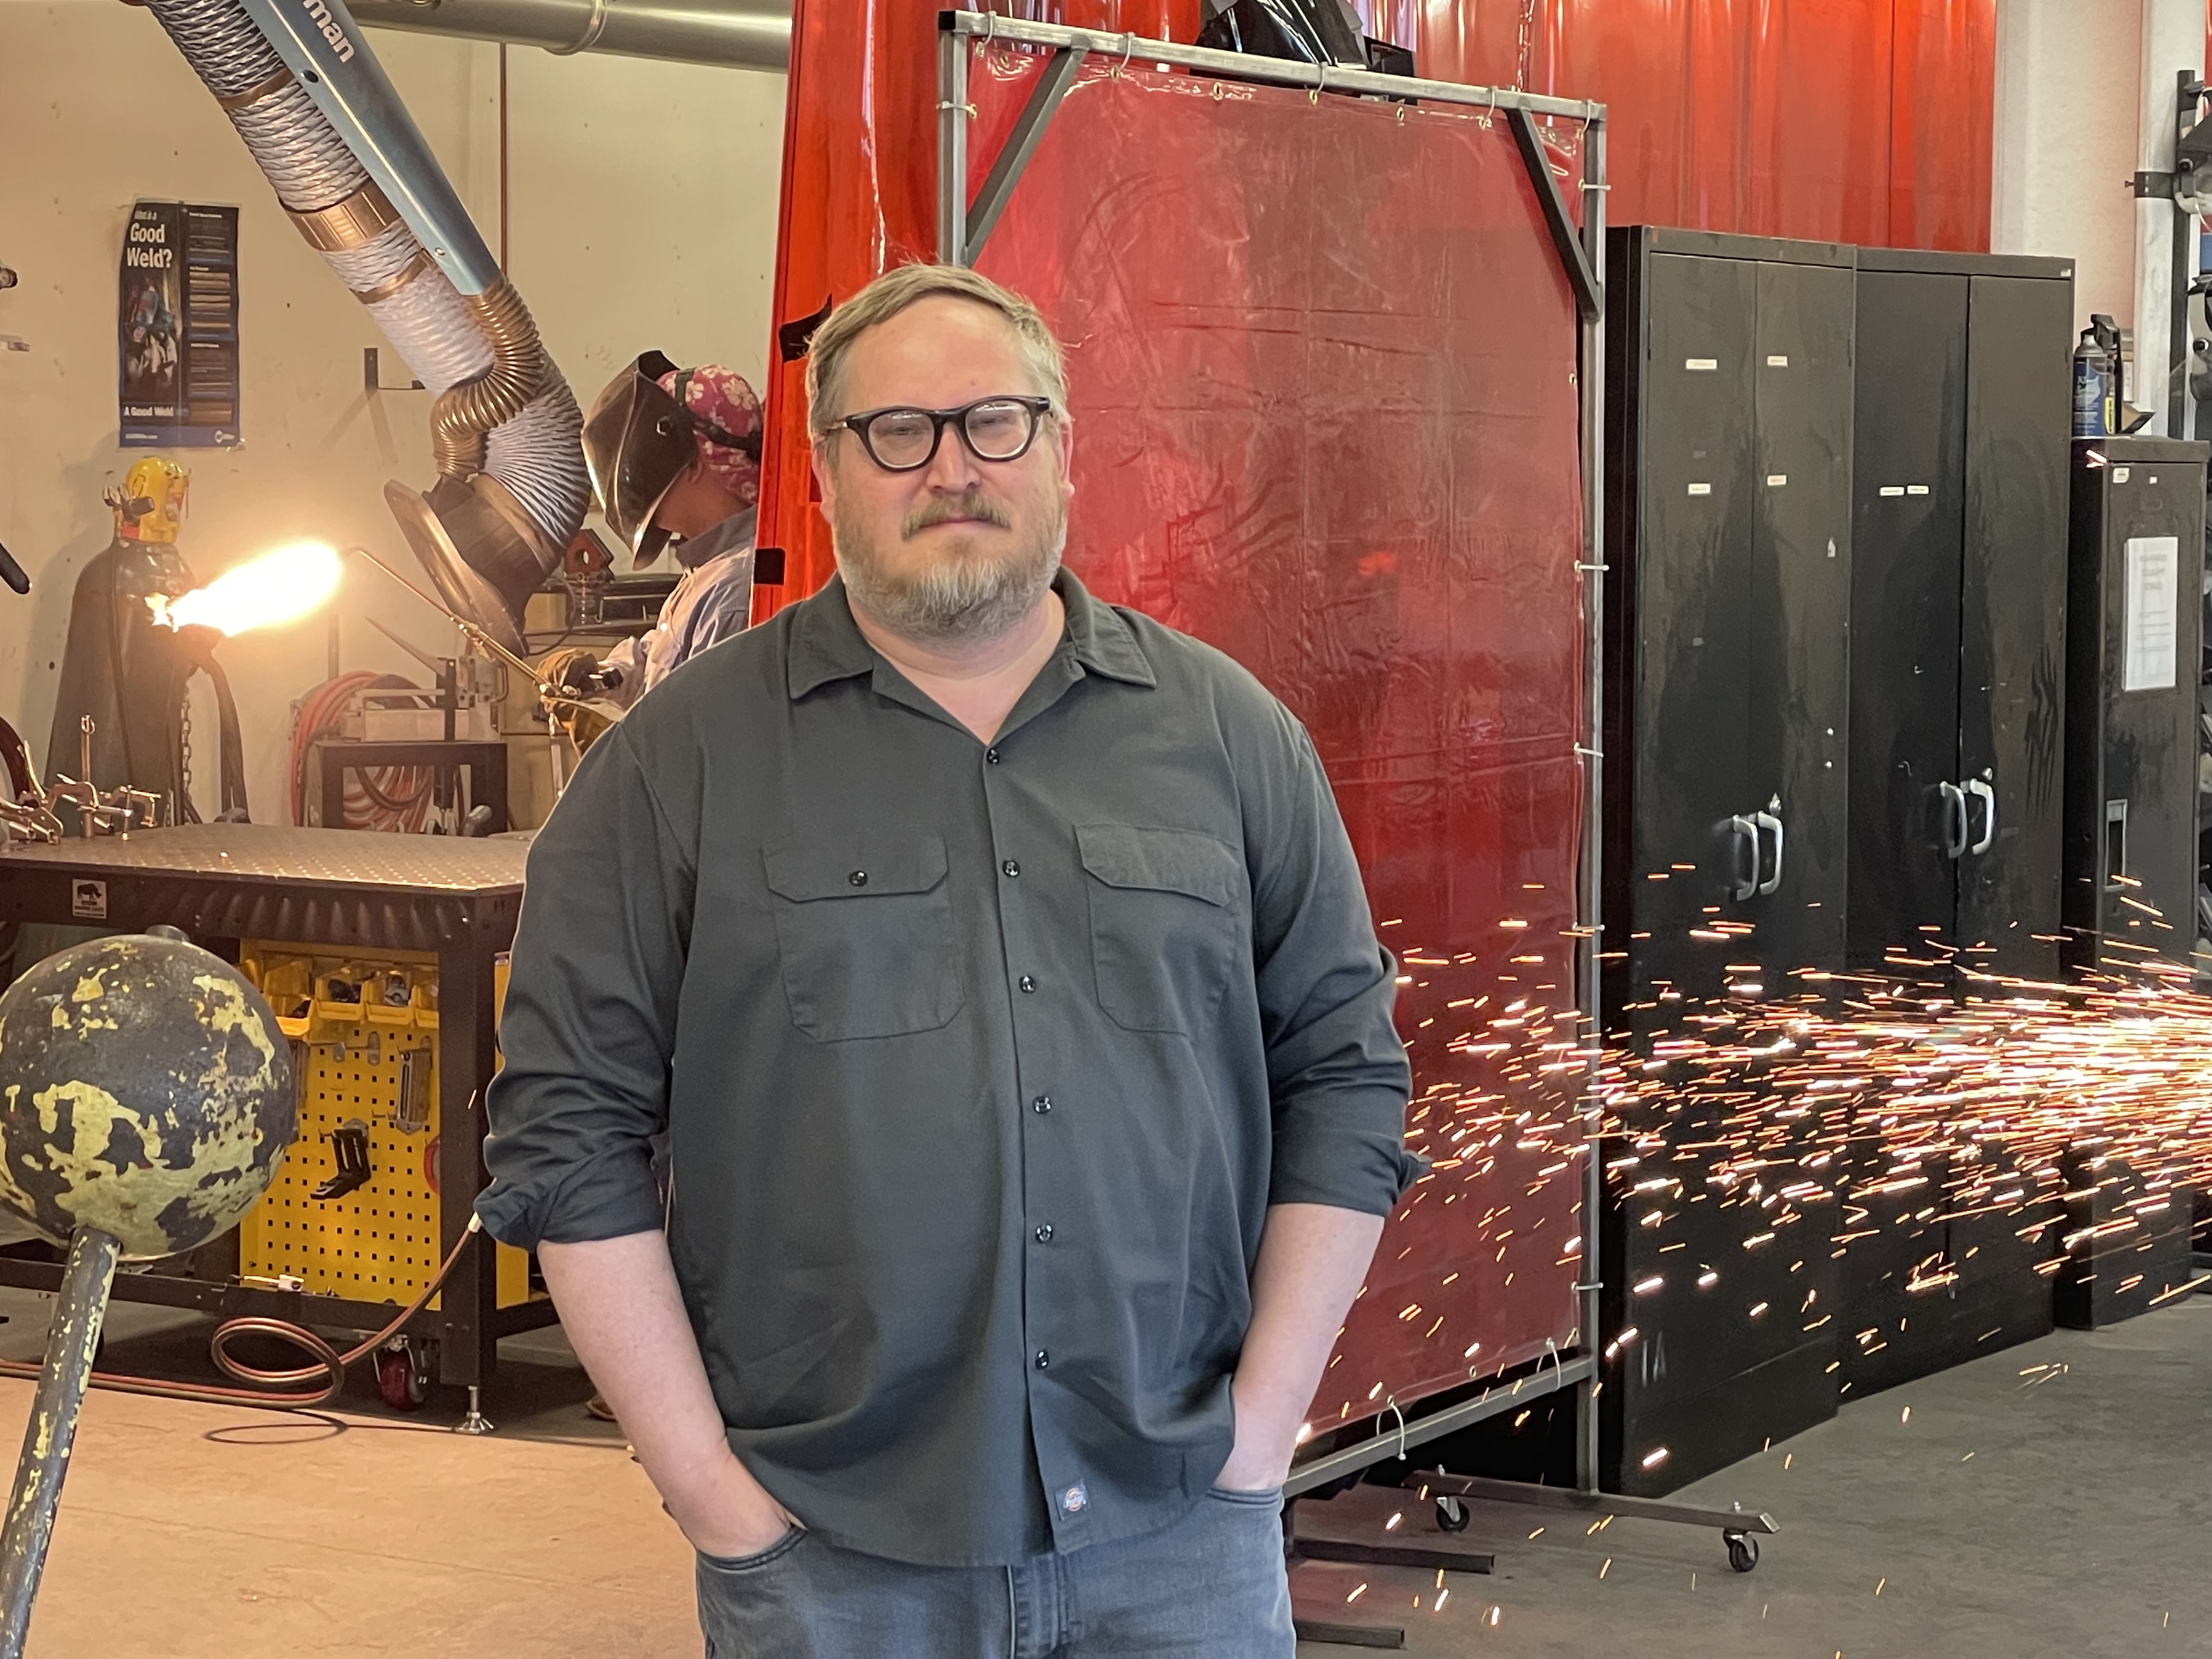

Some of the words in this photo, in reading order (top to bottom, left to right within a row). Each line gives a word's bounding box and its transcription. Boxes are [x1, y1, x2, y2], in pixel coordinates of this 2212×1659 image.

[131, 222, 165, 243] Good
[127, 247, 173, 268] Weld?
[131, 407, 153, 416] Good
